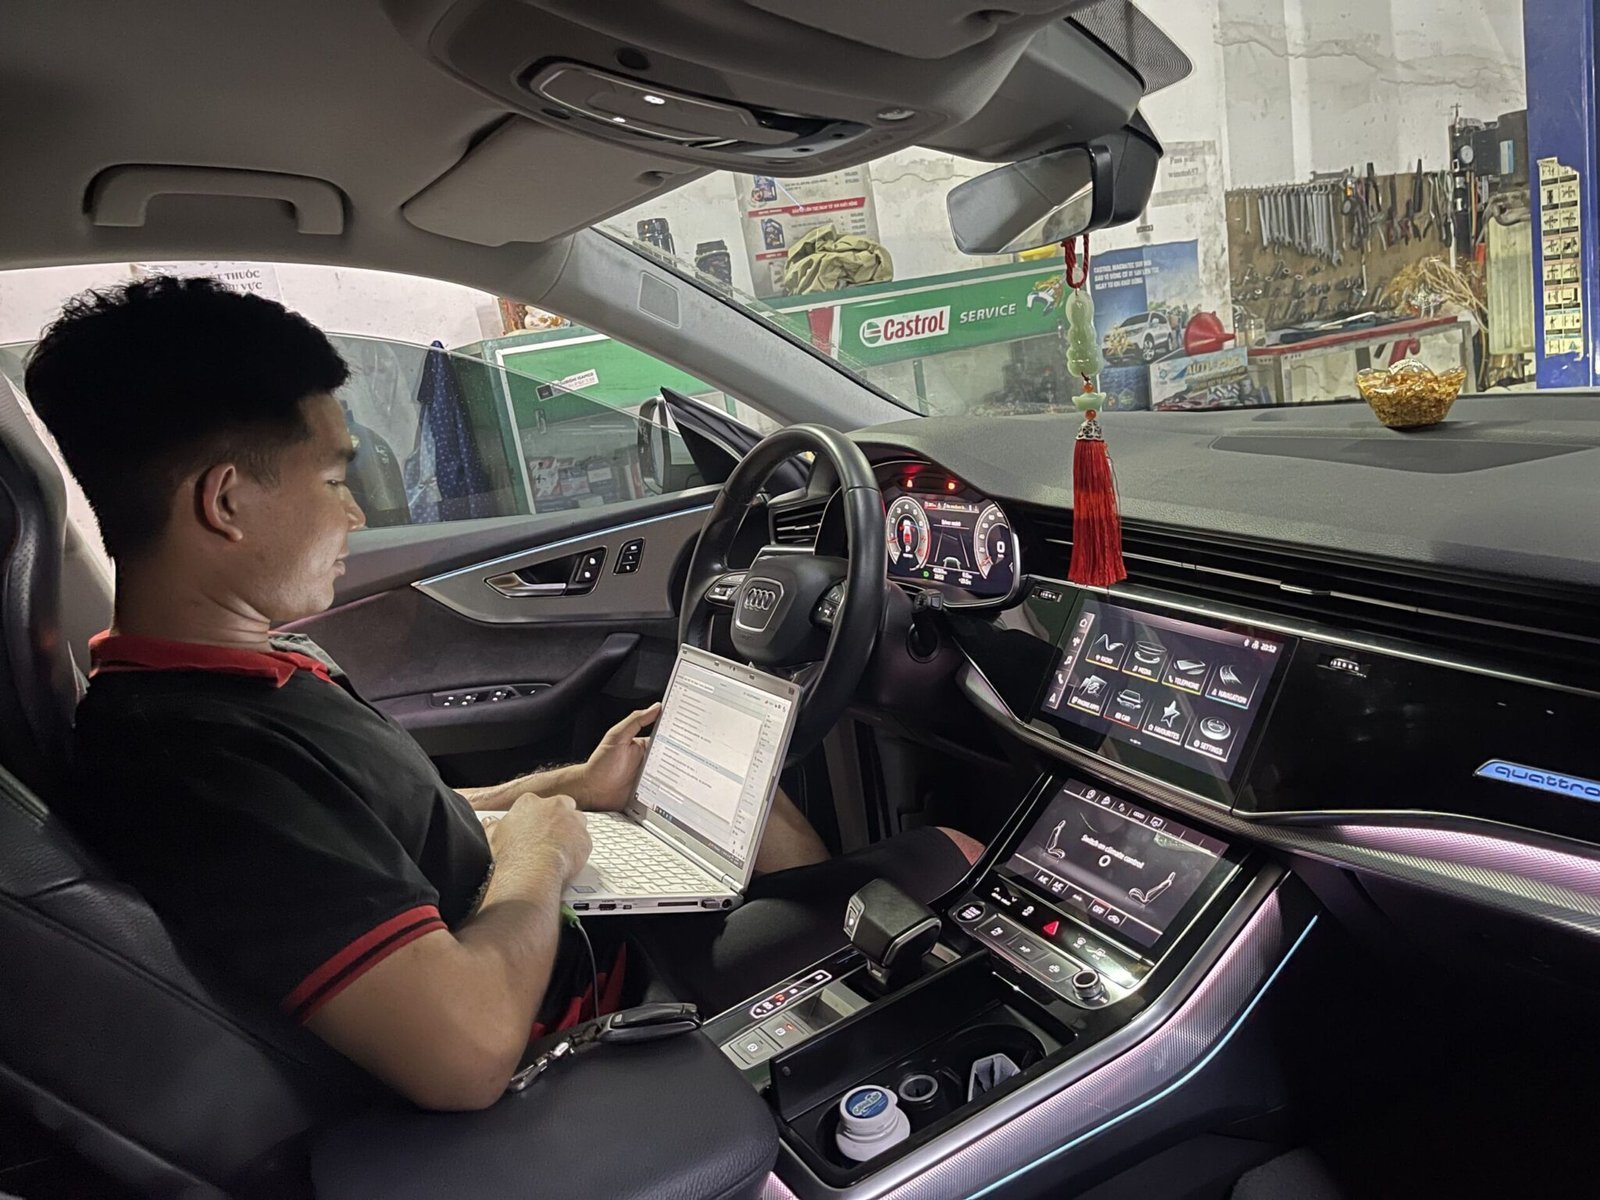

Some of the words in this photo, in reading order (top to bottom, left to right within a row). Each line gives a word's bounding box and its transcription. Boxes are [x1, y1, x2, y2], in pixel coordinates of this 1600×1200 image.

[883, 310, 945, 341] Castrol
[959, 304, 1016, 324] SERVICE
[996, 541, 1005, 553] 0
[1200, 742, 1223, 756] SETTINGS
[1495, 766, 1600, 797] quattro
